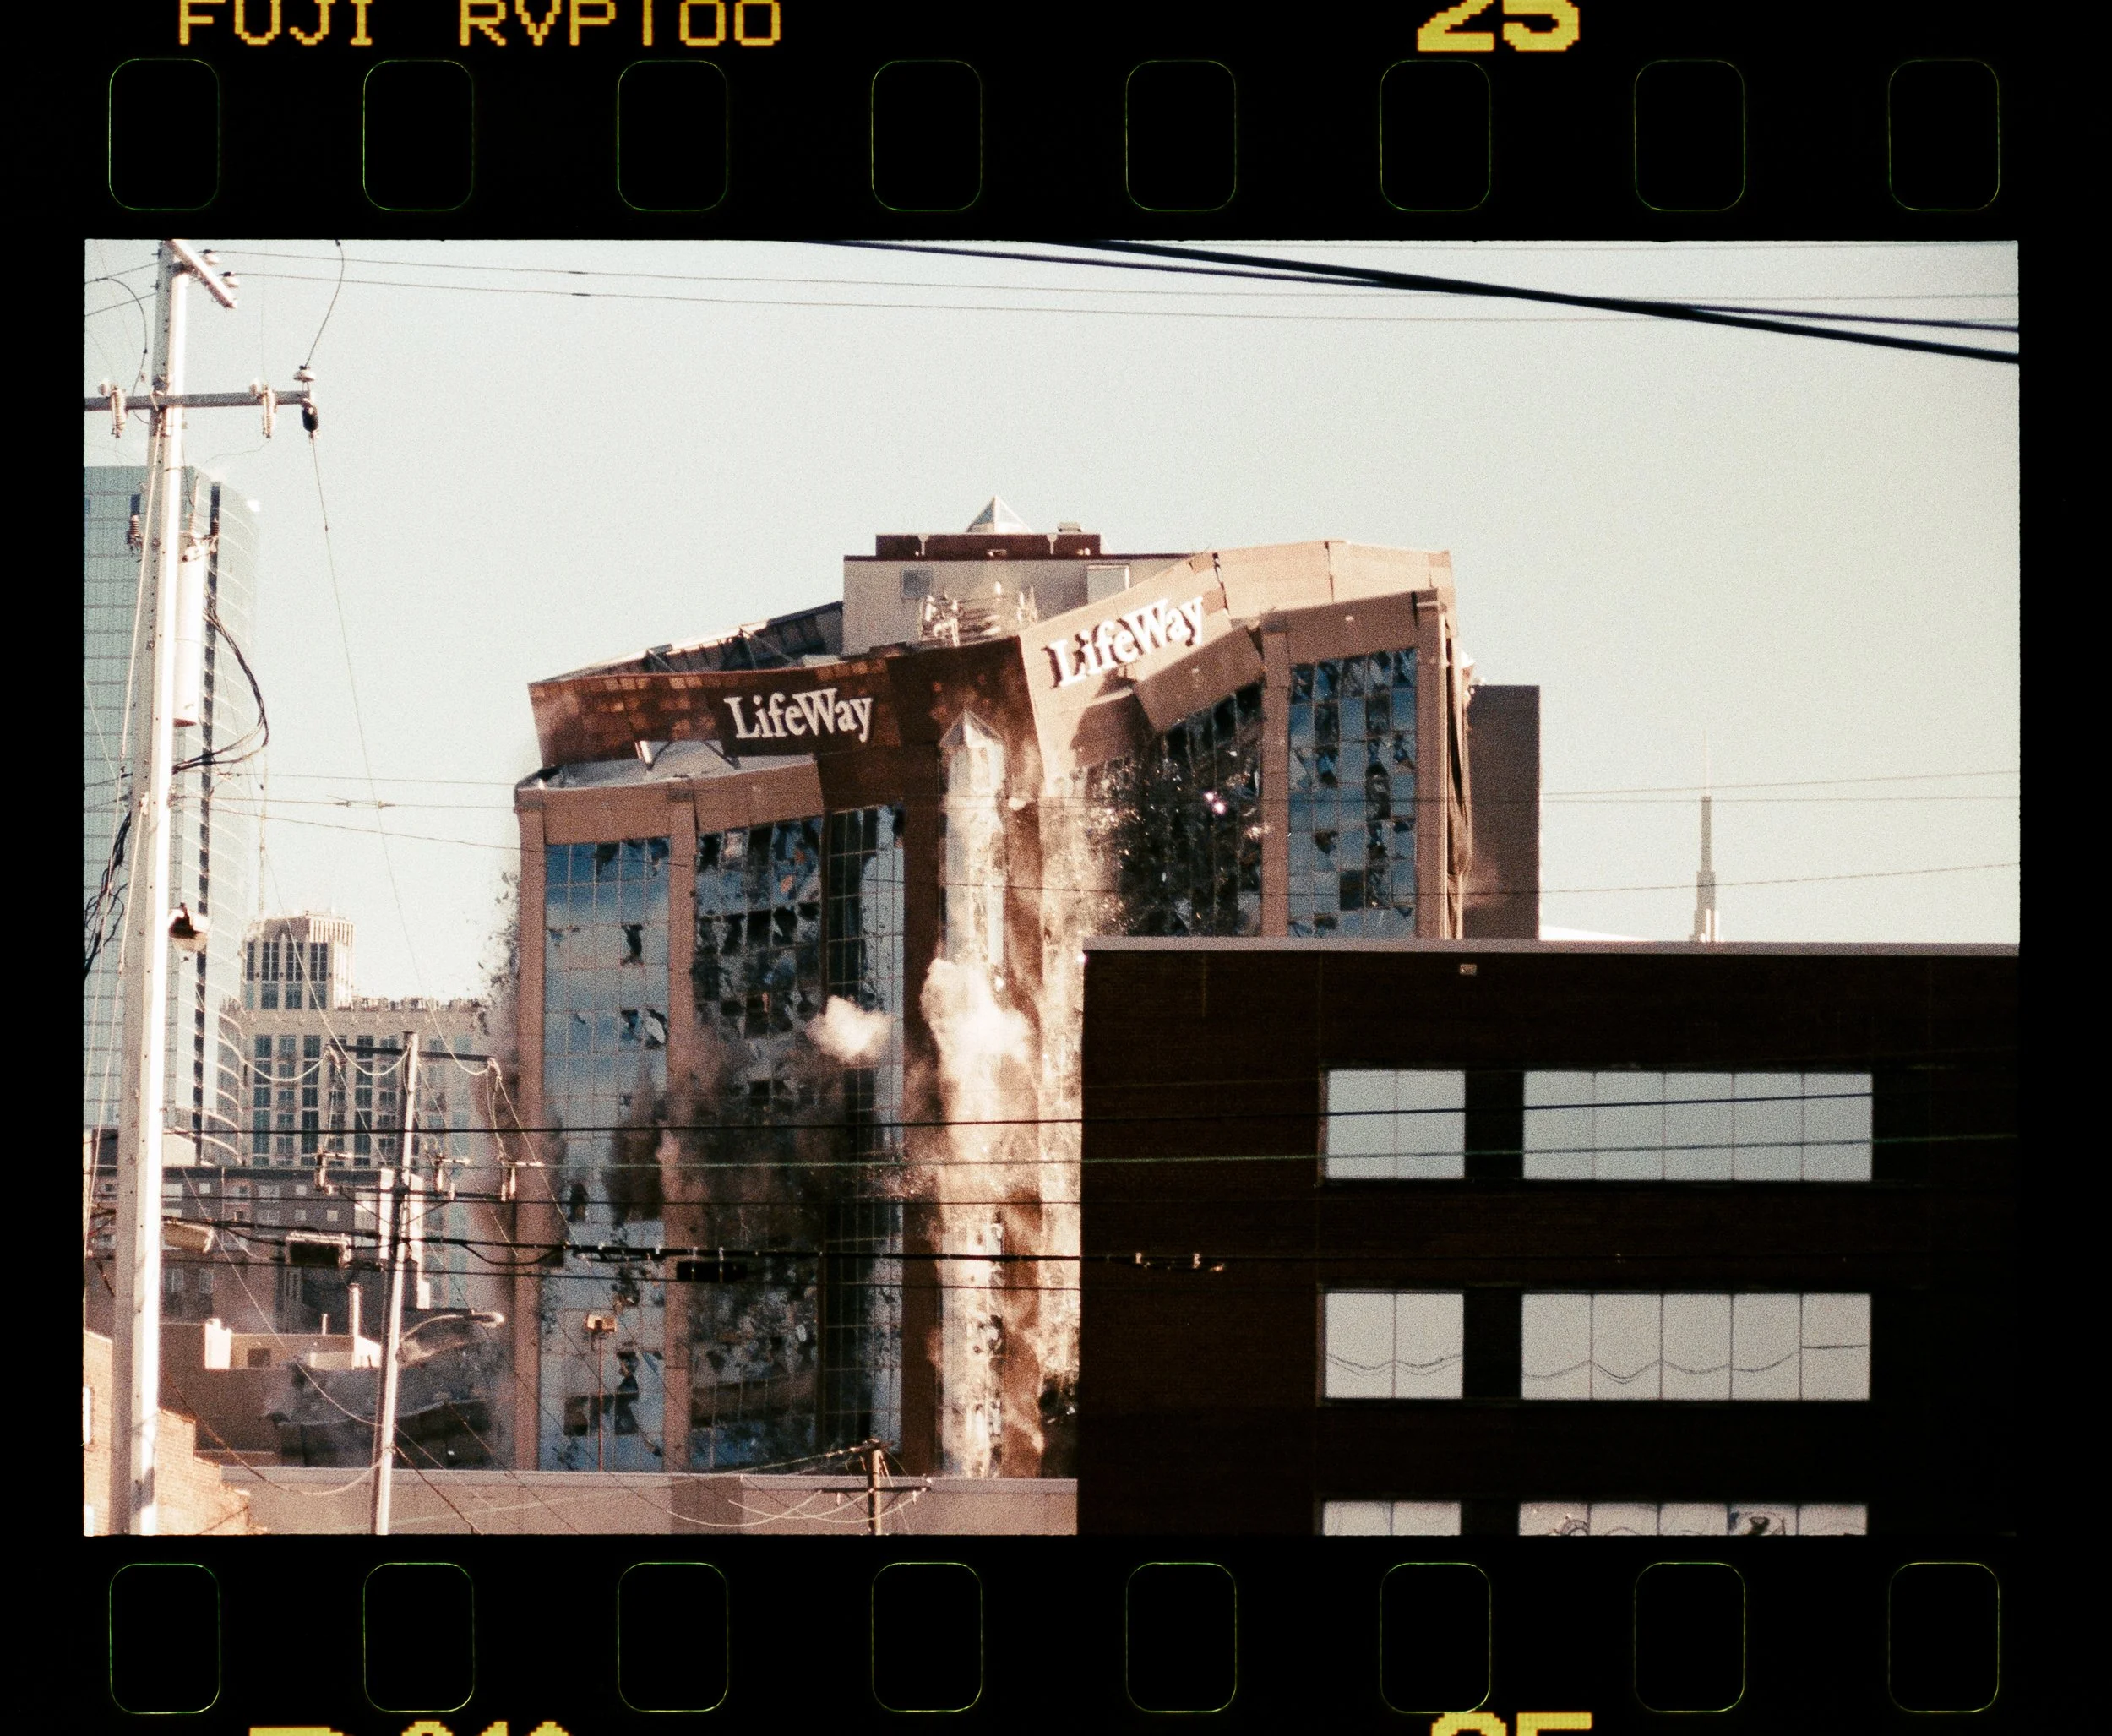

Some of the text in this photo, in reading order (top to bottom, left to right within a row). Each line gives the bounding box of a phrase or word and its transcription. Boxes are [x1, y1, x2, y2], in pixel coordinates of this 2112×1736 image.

[178, 0, 781, 46] FUJI RVP100
[1417, 0, 1580, 52] 25
[1048, 595, 1204, 688] LifeWay
[723, 688, 874, 743] LifeWay
